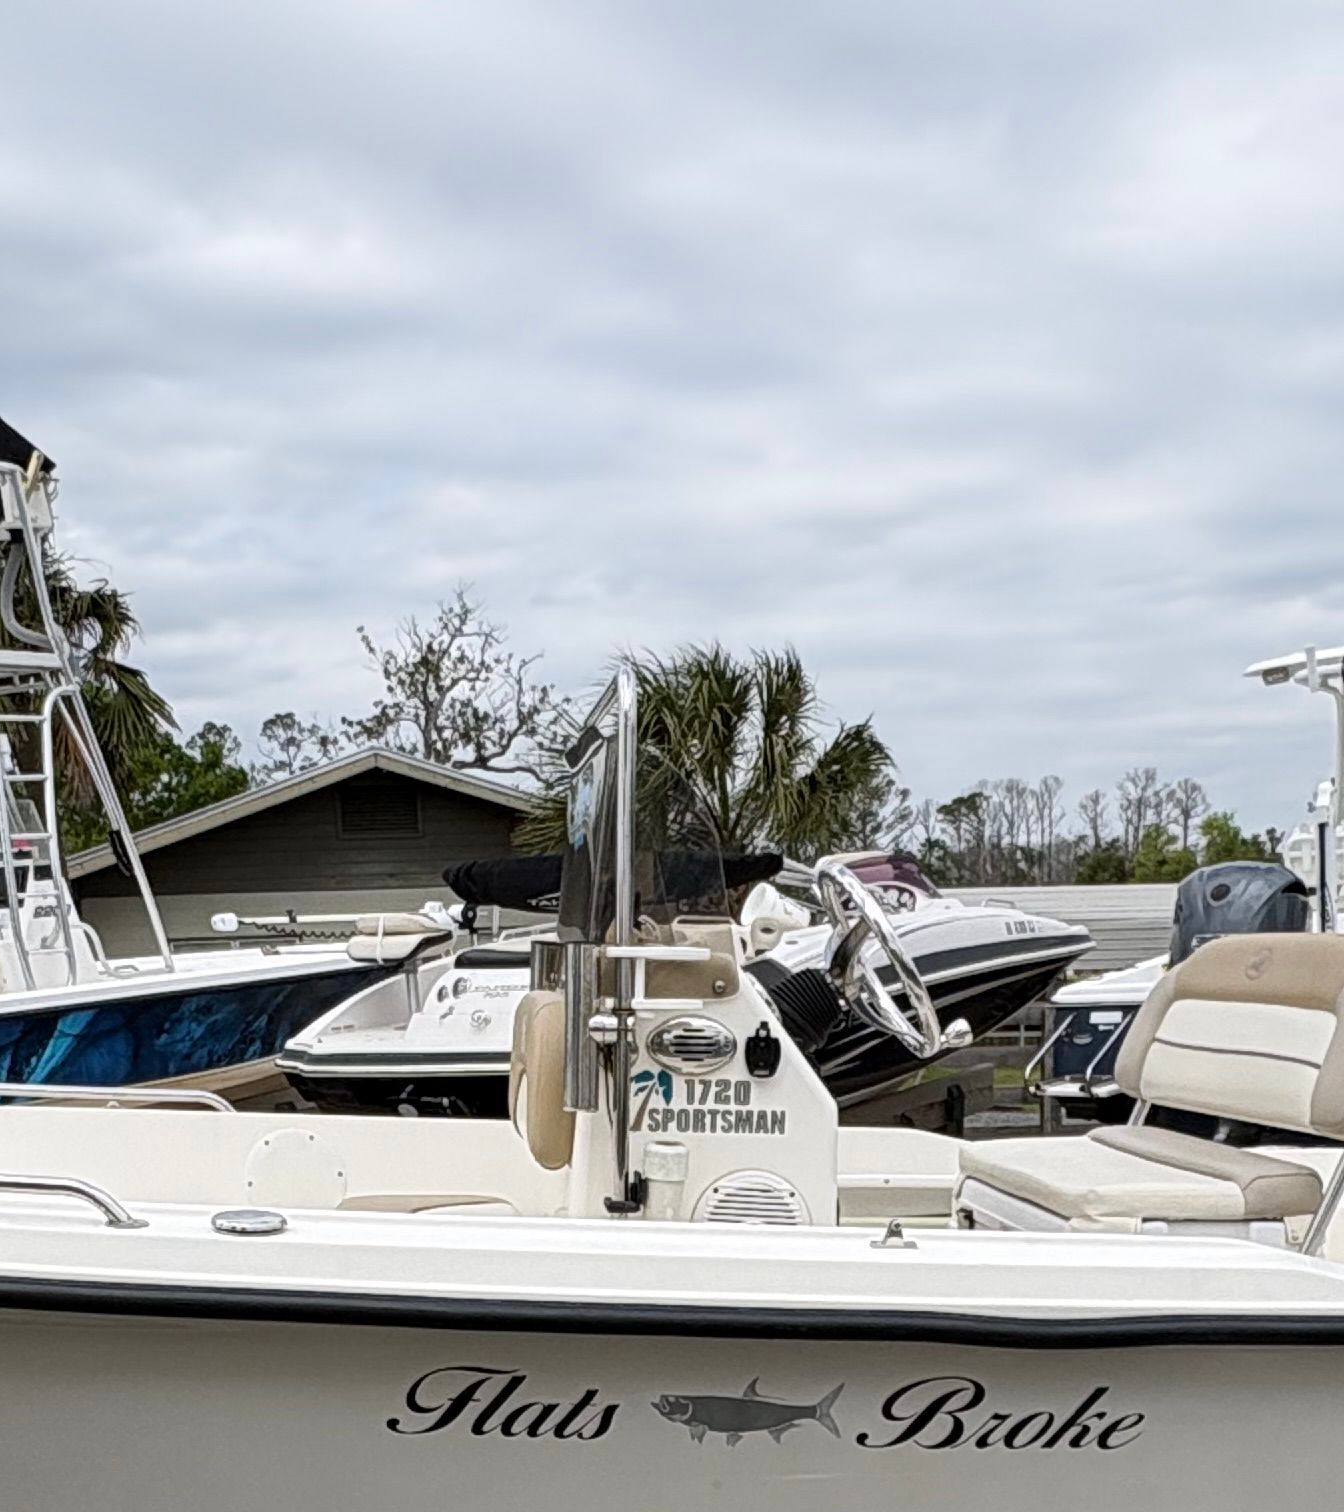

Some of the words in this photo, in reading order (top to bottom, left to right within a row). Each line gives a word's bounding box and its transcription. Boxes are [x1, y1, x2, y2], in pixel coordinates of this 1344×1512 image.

[684, 1078, 752, 1106] 1720
[647, 1108, 787, 1135] SPORTSMAN
[386, 1366, 622, 1441] Flats
[855, 1375, 1147, 1451] Broke
